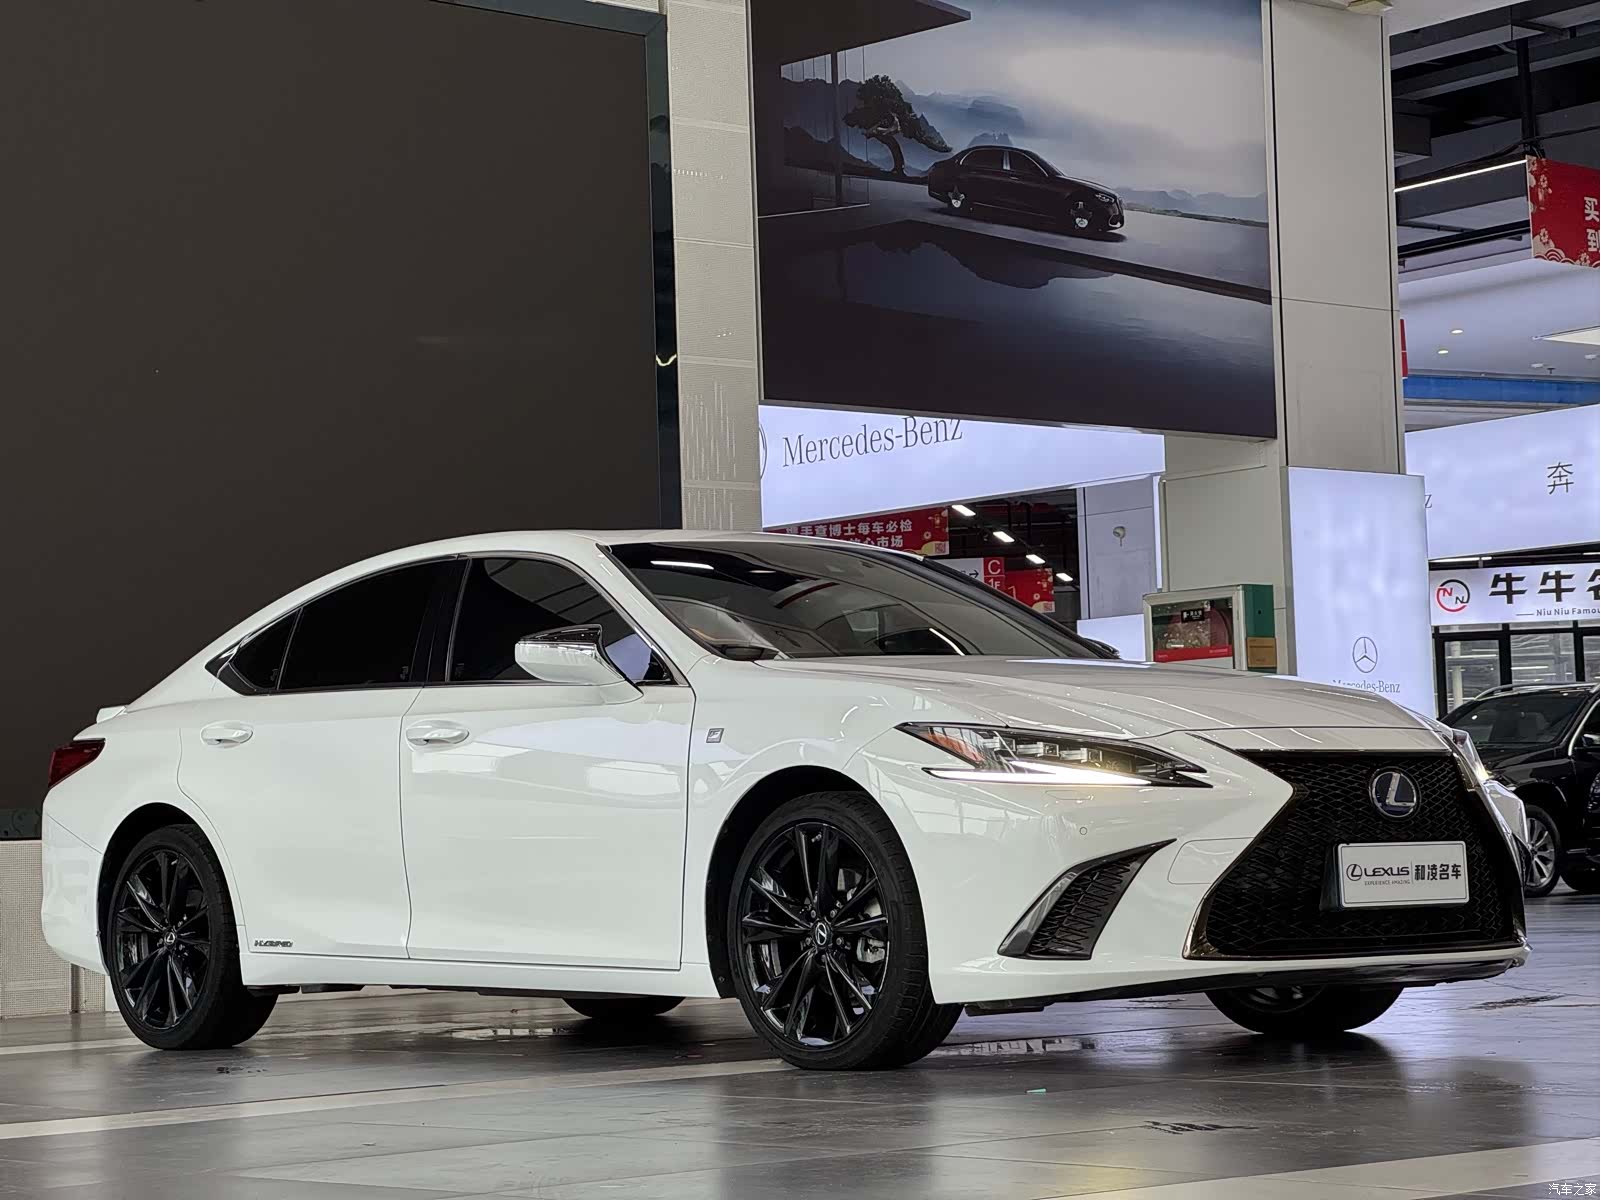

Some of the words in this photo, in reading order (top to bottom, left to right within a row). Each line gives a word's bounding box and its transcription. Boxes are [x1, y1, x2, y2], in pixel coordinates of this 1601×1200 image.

[782, 416, 963, 467] Mercedes-Benz
[1547, 462, 1574, 495] 奔
[988, 560, 1000, 575] C
[1364, 867, 1409, 877] LEXUS
[1414, 864, 1462, 881] 和凌名车
